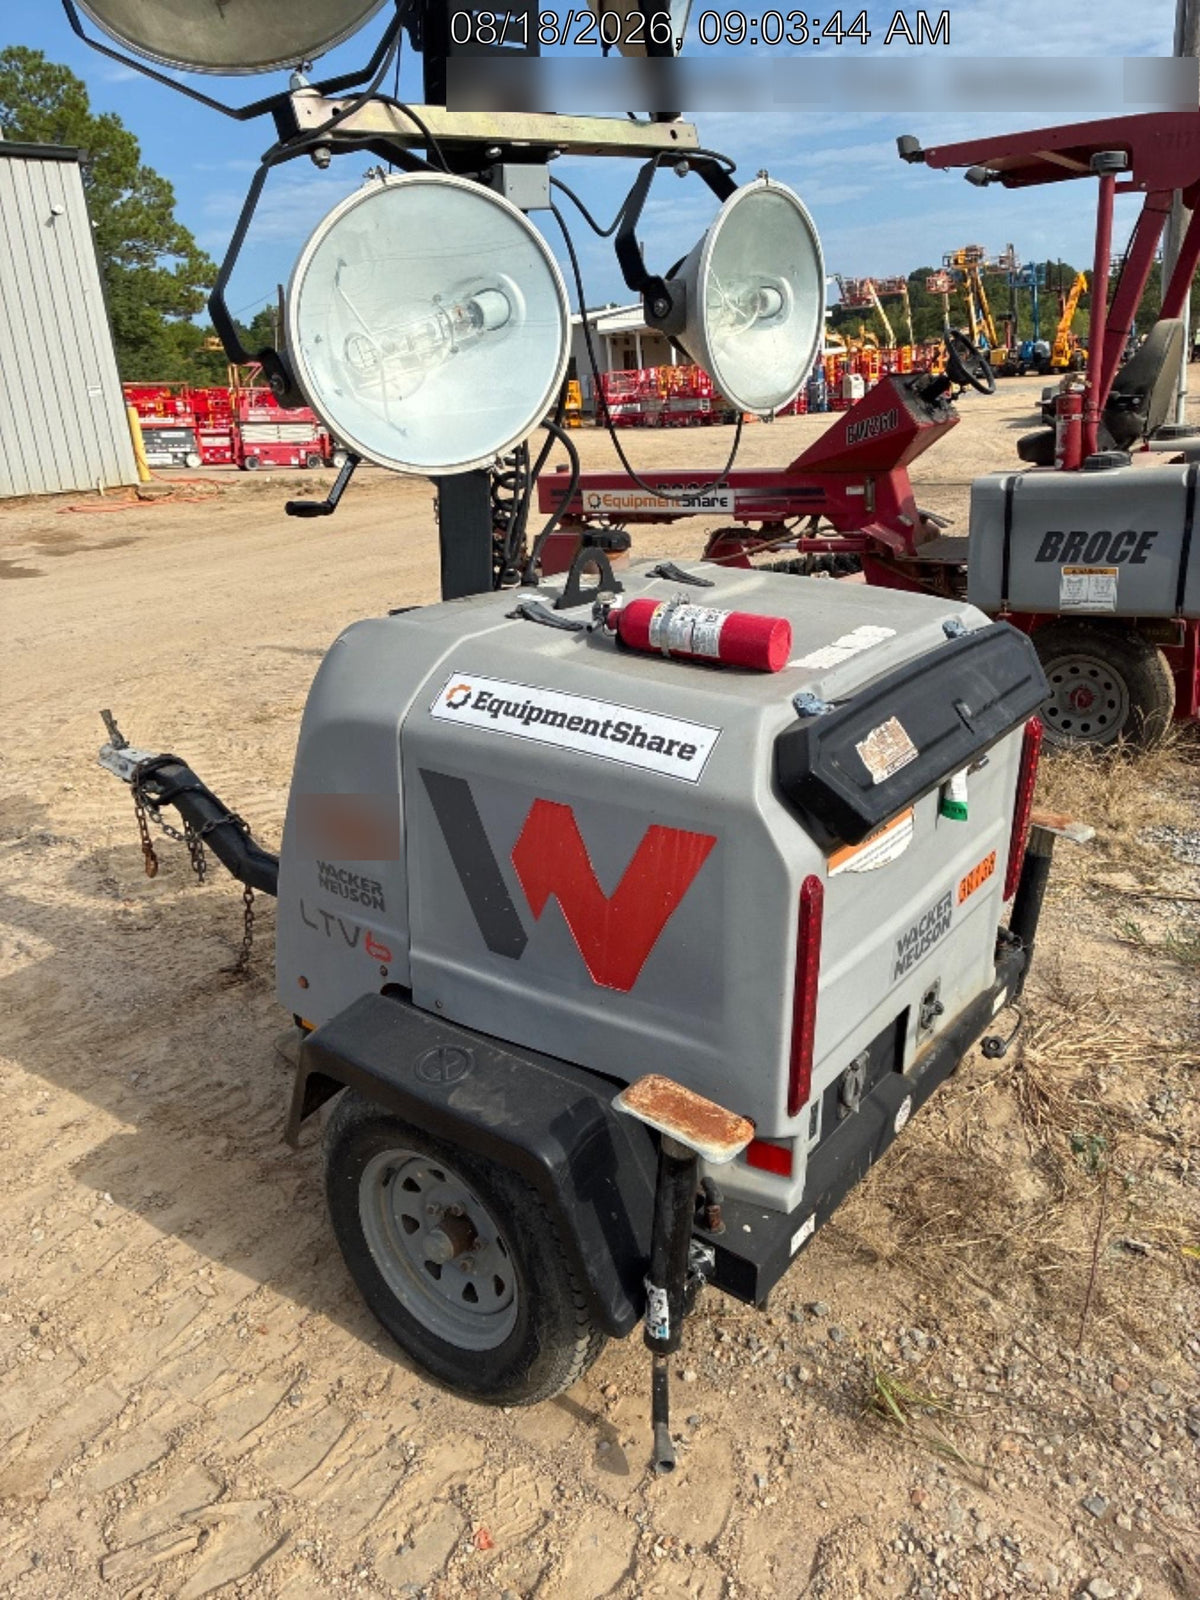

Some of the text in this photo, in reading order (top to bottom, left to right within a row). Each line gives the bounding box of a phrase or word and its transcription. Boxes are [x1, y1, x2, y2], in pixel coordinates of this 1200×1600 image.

[1034, 530, 1159, 564] BROCE
[470, 690, 699, 762] EquipmentShare
[316, 859, 384, 896] WACKER
[318, 874, 387, 913] NEUSON
[893, 910, 953, 980] NEUSON
[897, 890, 952, 957] WACKER
